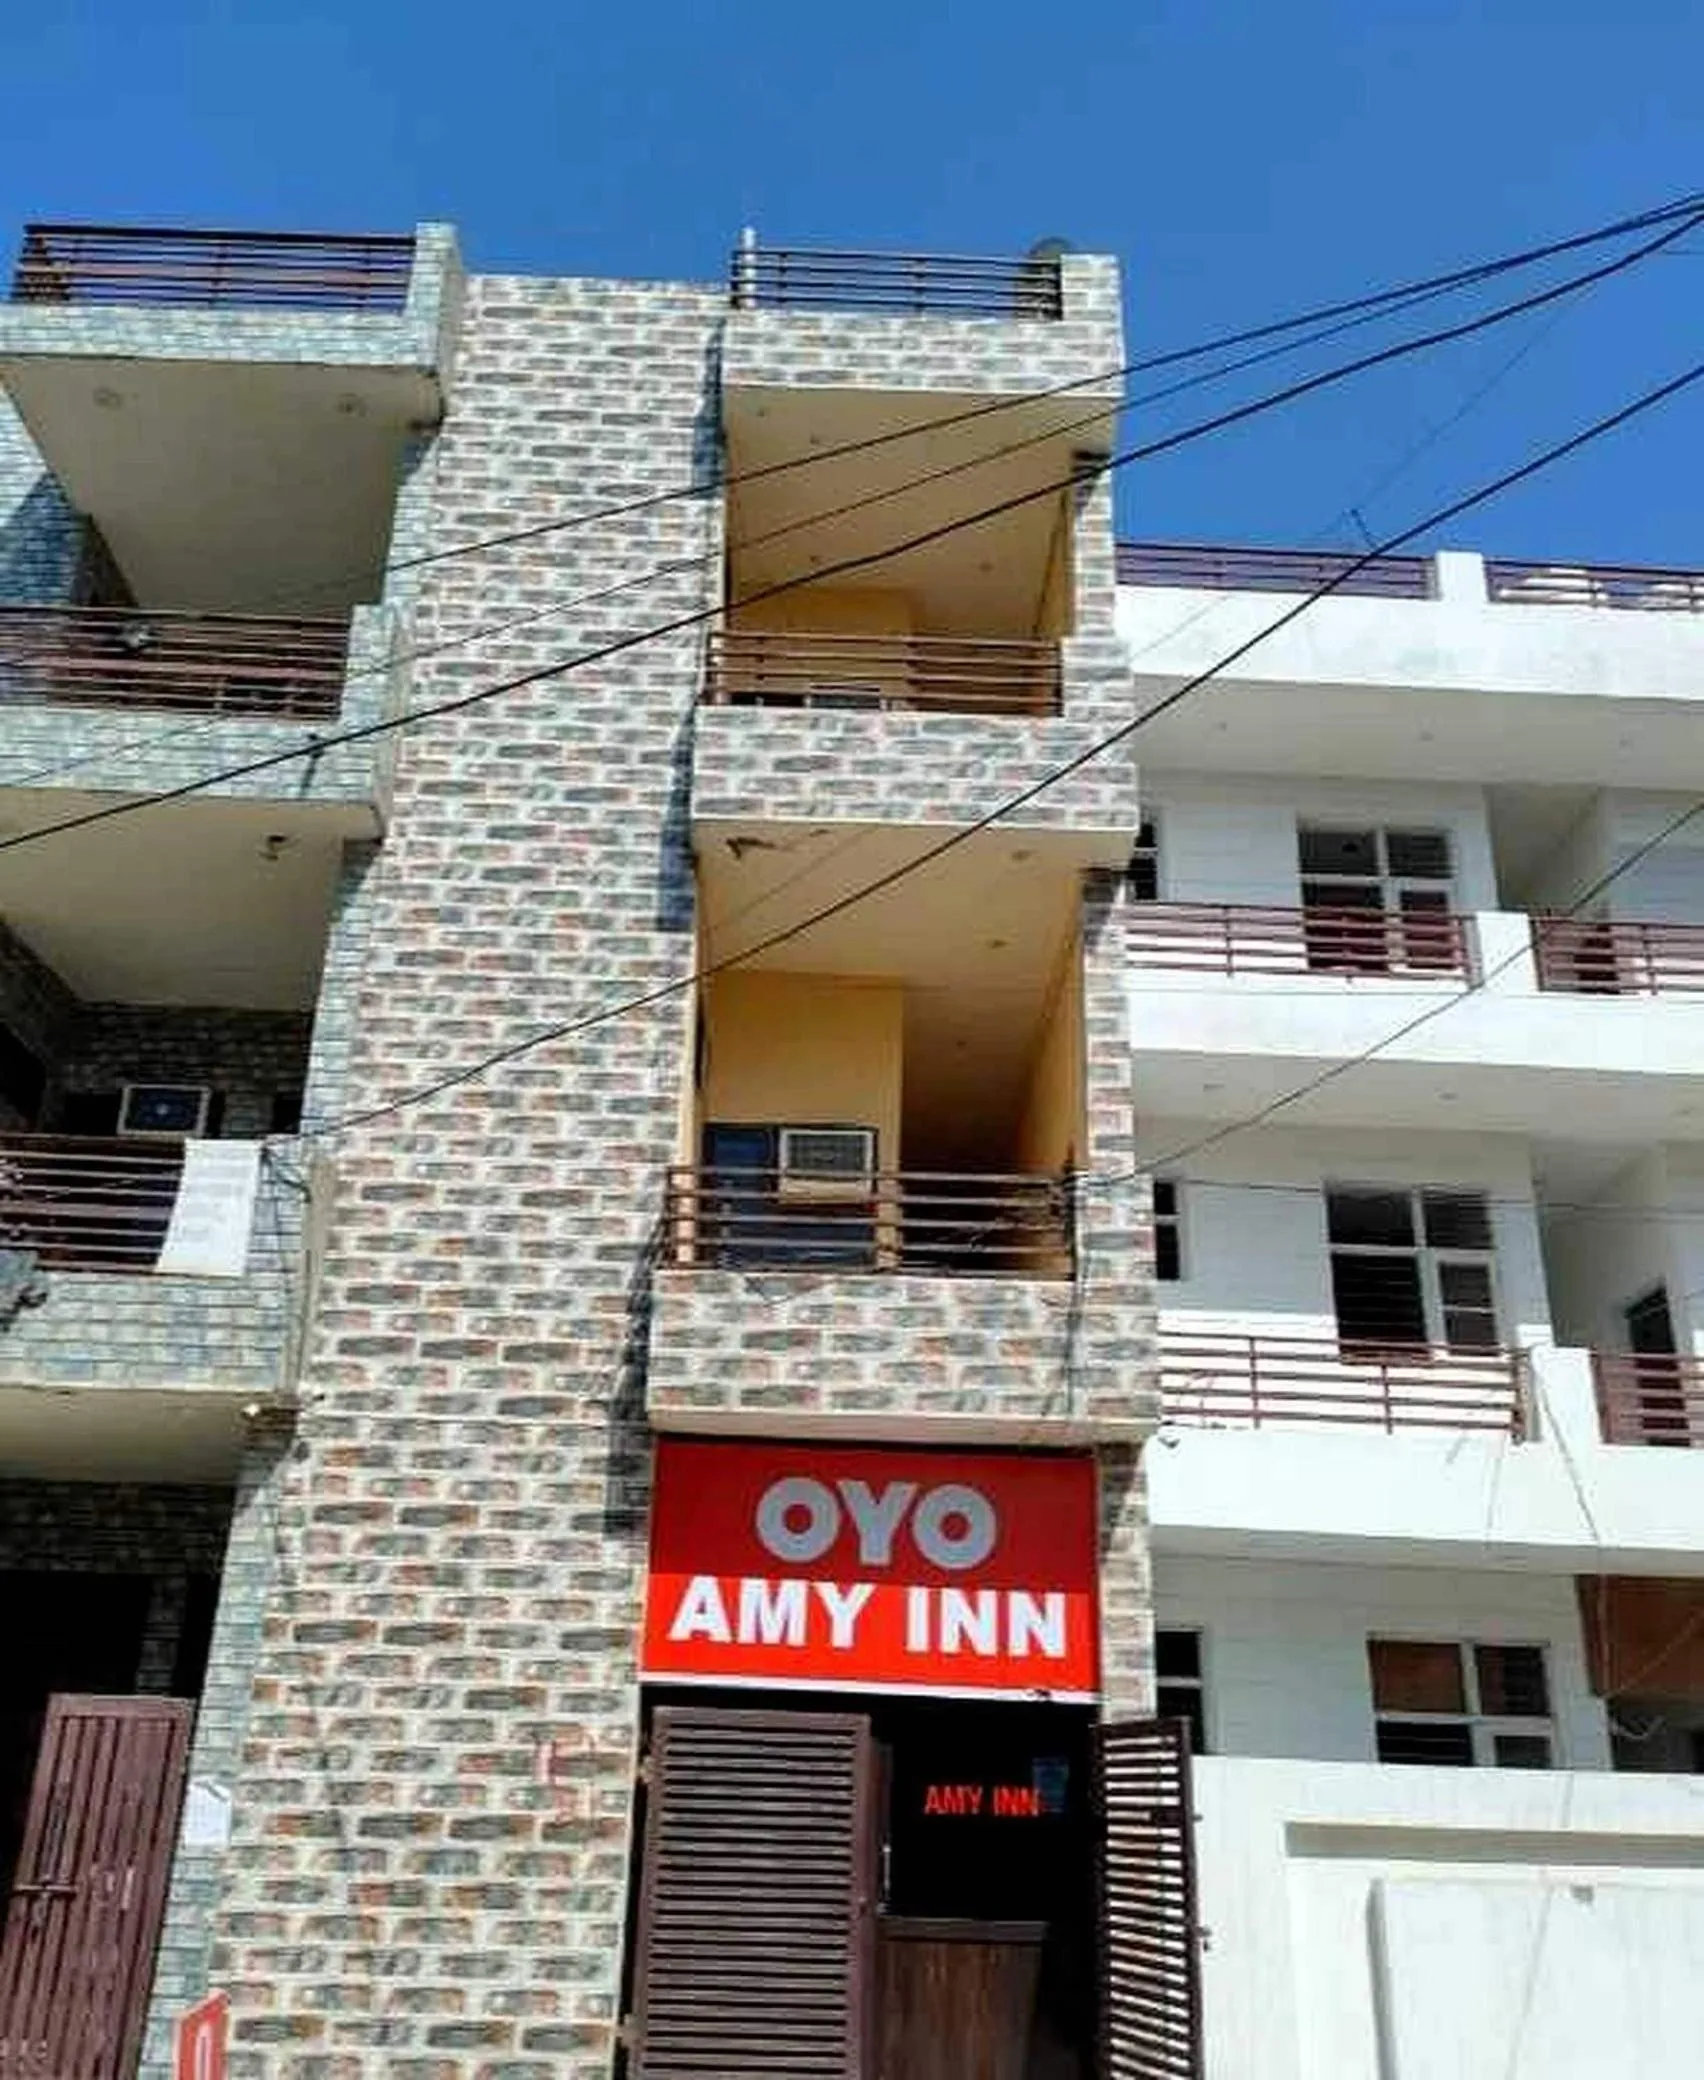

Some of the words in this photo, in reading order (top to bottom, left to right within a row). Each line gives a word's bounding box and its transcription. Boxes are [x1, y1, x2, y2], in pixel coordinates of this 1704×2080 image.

[756, 1477, 997, 1570] OYO
[668, 1575, 876, 1649] AMY
[906, 1586, 1067, 1659] INN
[924, 1785, 983, 1815] AMY
[993, 1786, 1040, 1817] INN
